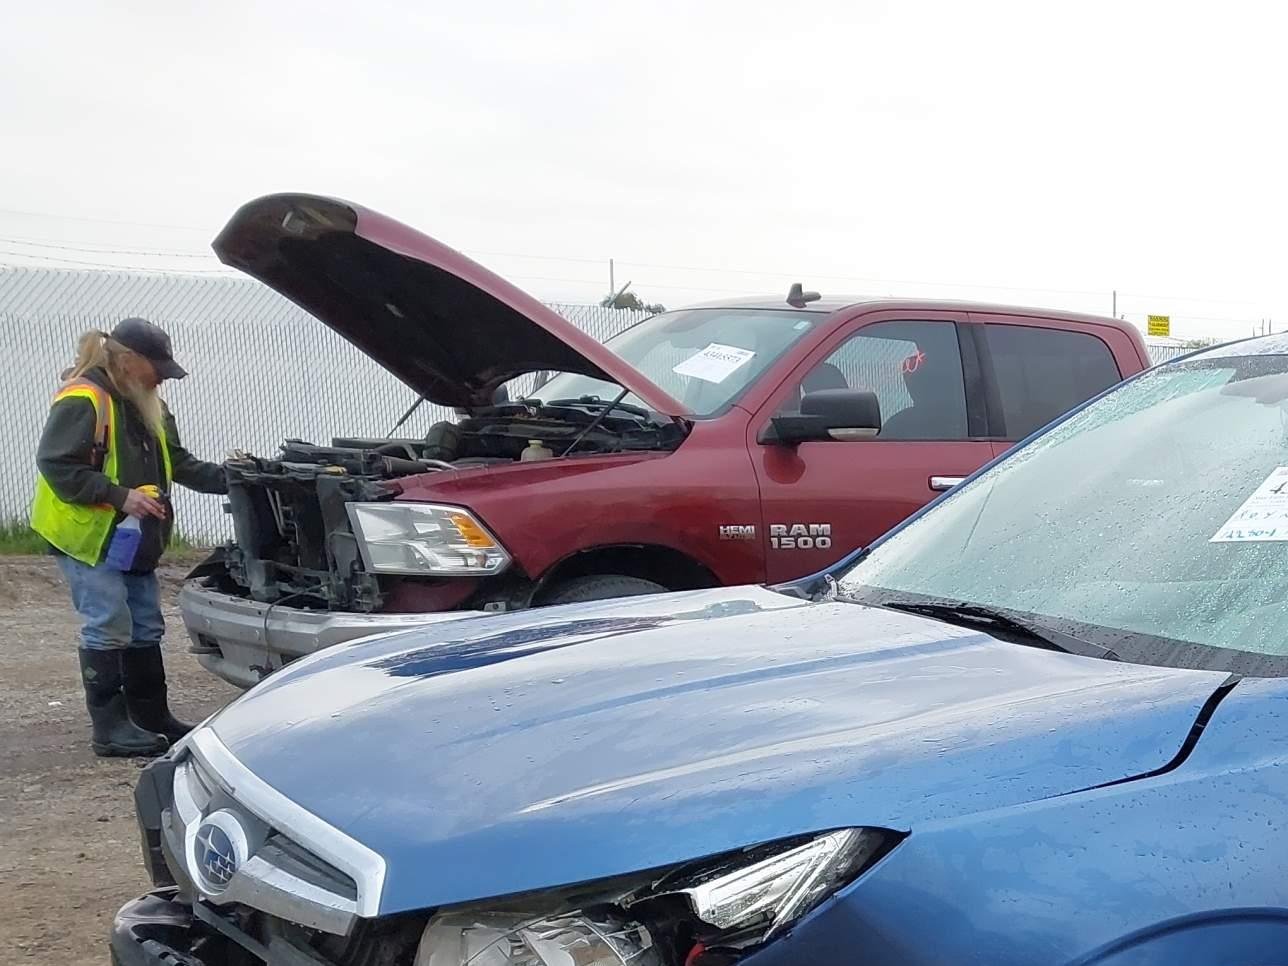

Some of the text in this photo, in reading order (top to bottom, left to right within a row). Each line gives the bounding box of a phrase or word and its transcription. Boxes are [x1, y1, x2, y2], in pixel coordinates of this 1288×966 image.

[719, 525, 755, 535] HEMI
[770, 523, 831, 537] RAM
[770, 536, 832, 549] 1500
